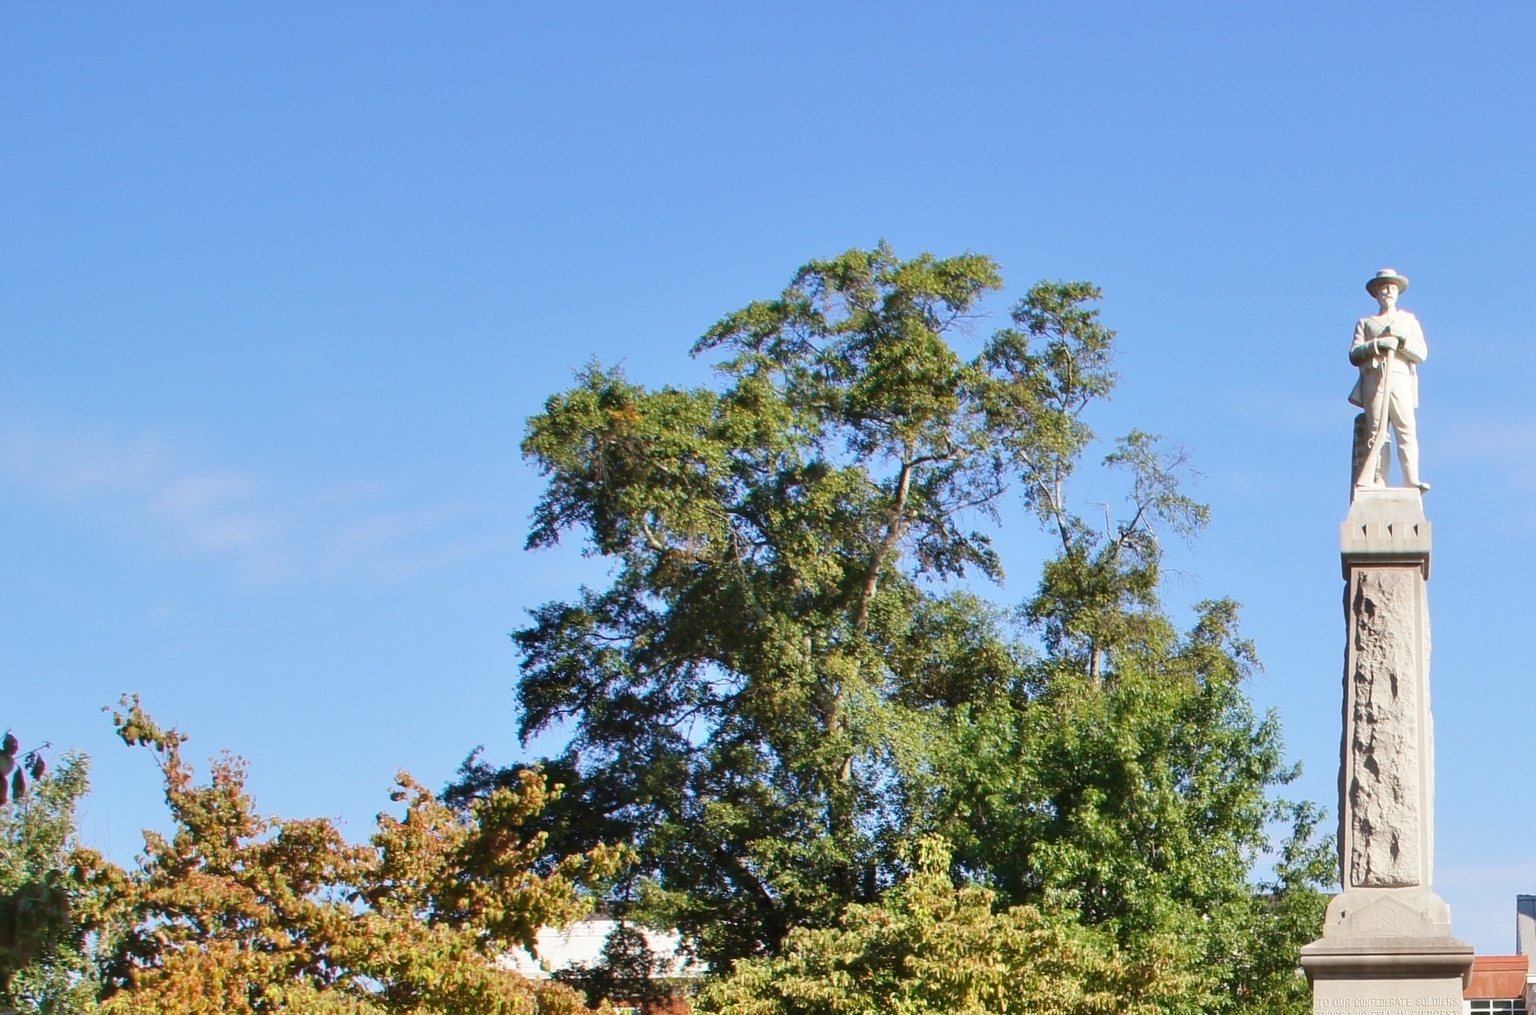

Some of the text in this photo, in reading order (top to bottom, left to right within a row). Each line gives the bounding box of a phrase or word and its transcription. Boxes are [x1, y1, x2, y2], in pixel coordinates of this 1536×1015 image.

[1317, 996, 1461, 1008] TO OUR CONFEDERATE SOLDIERS,
